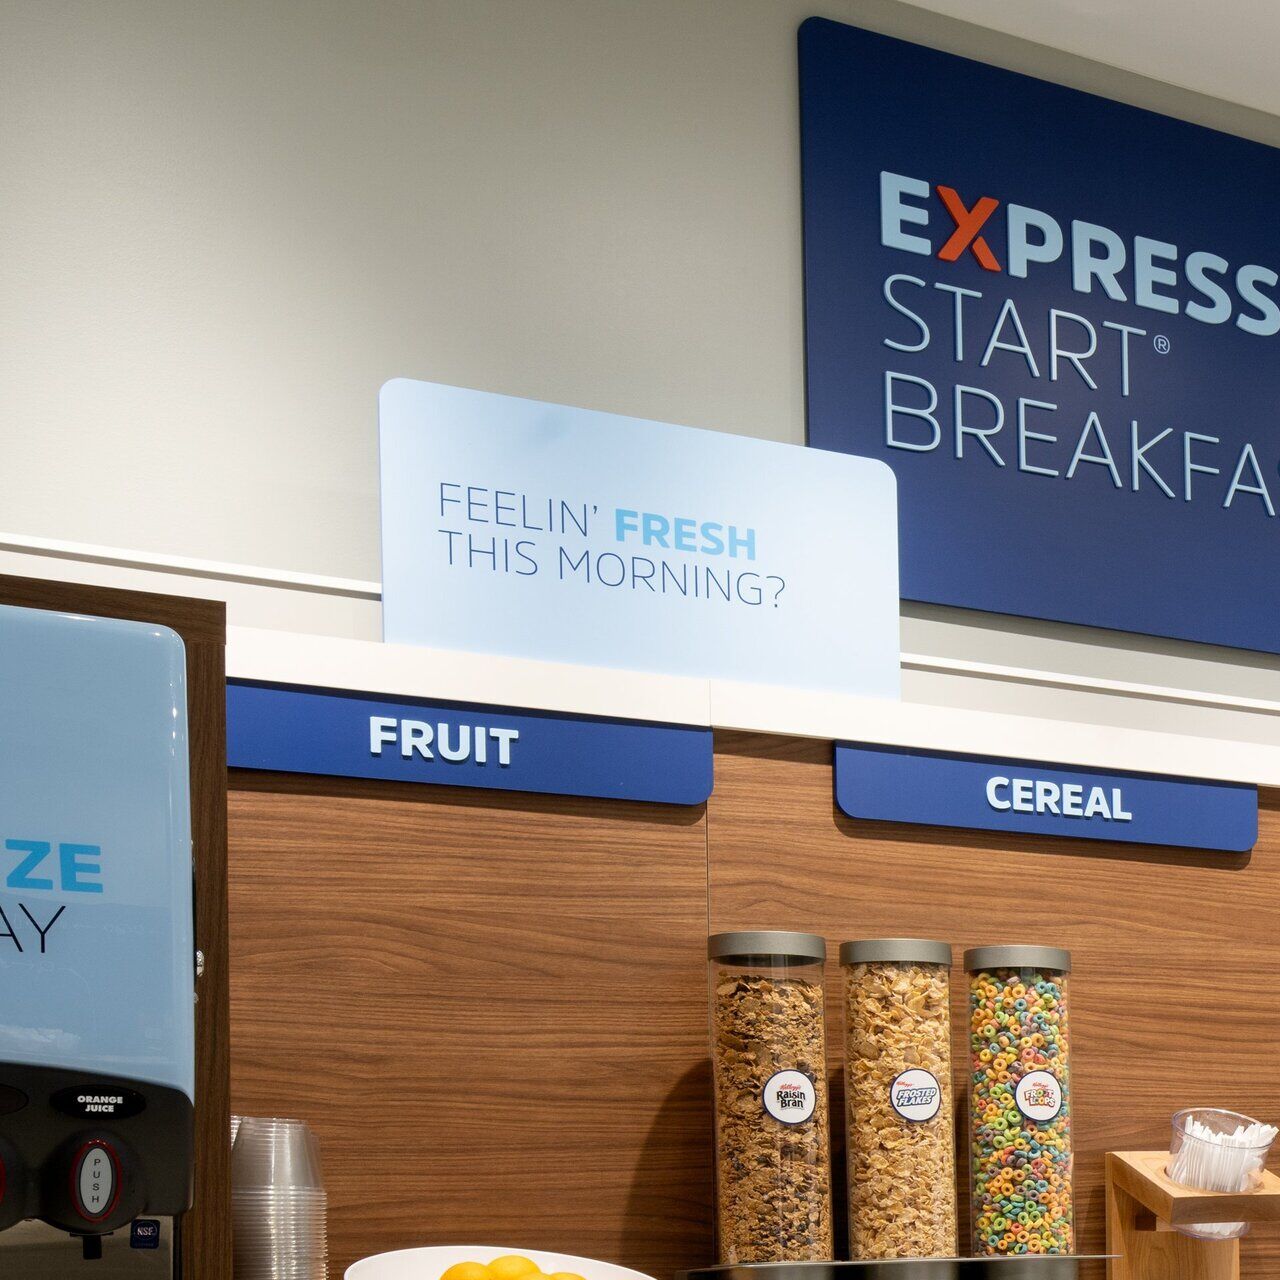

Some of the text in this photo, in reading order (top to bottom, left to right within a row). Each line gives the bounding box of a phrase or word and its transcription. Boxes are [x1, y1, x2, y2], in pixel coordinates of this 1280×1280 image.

[614, 508, 757, 561] FRESH
[438, 529, 786, 608] THIS MORNING?
[369, 716, 520, 765] FRUIT
[985, 776, 1133, 821] CEREAL
[776, 1091, 806, 1101] Raisin
[897, 1087, 937, 1099] FROSTED
[77, 1095, 123, 1104] ORANGE
[781, 1100, 803, 1108] Bran
[897, 1096, 933, 1107] FLAKES
[85, 1104, 114, 1112] JUICE
[91, 1158, 101, 1203] PUSH
[137, 1227, 153, 1236] NSF
